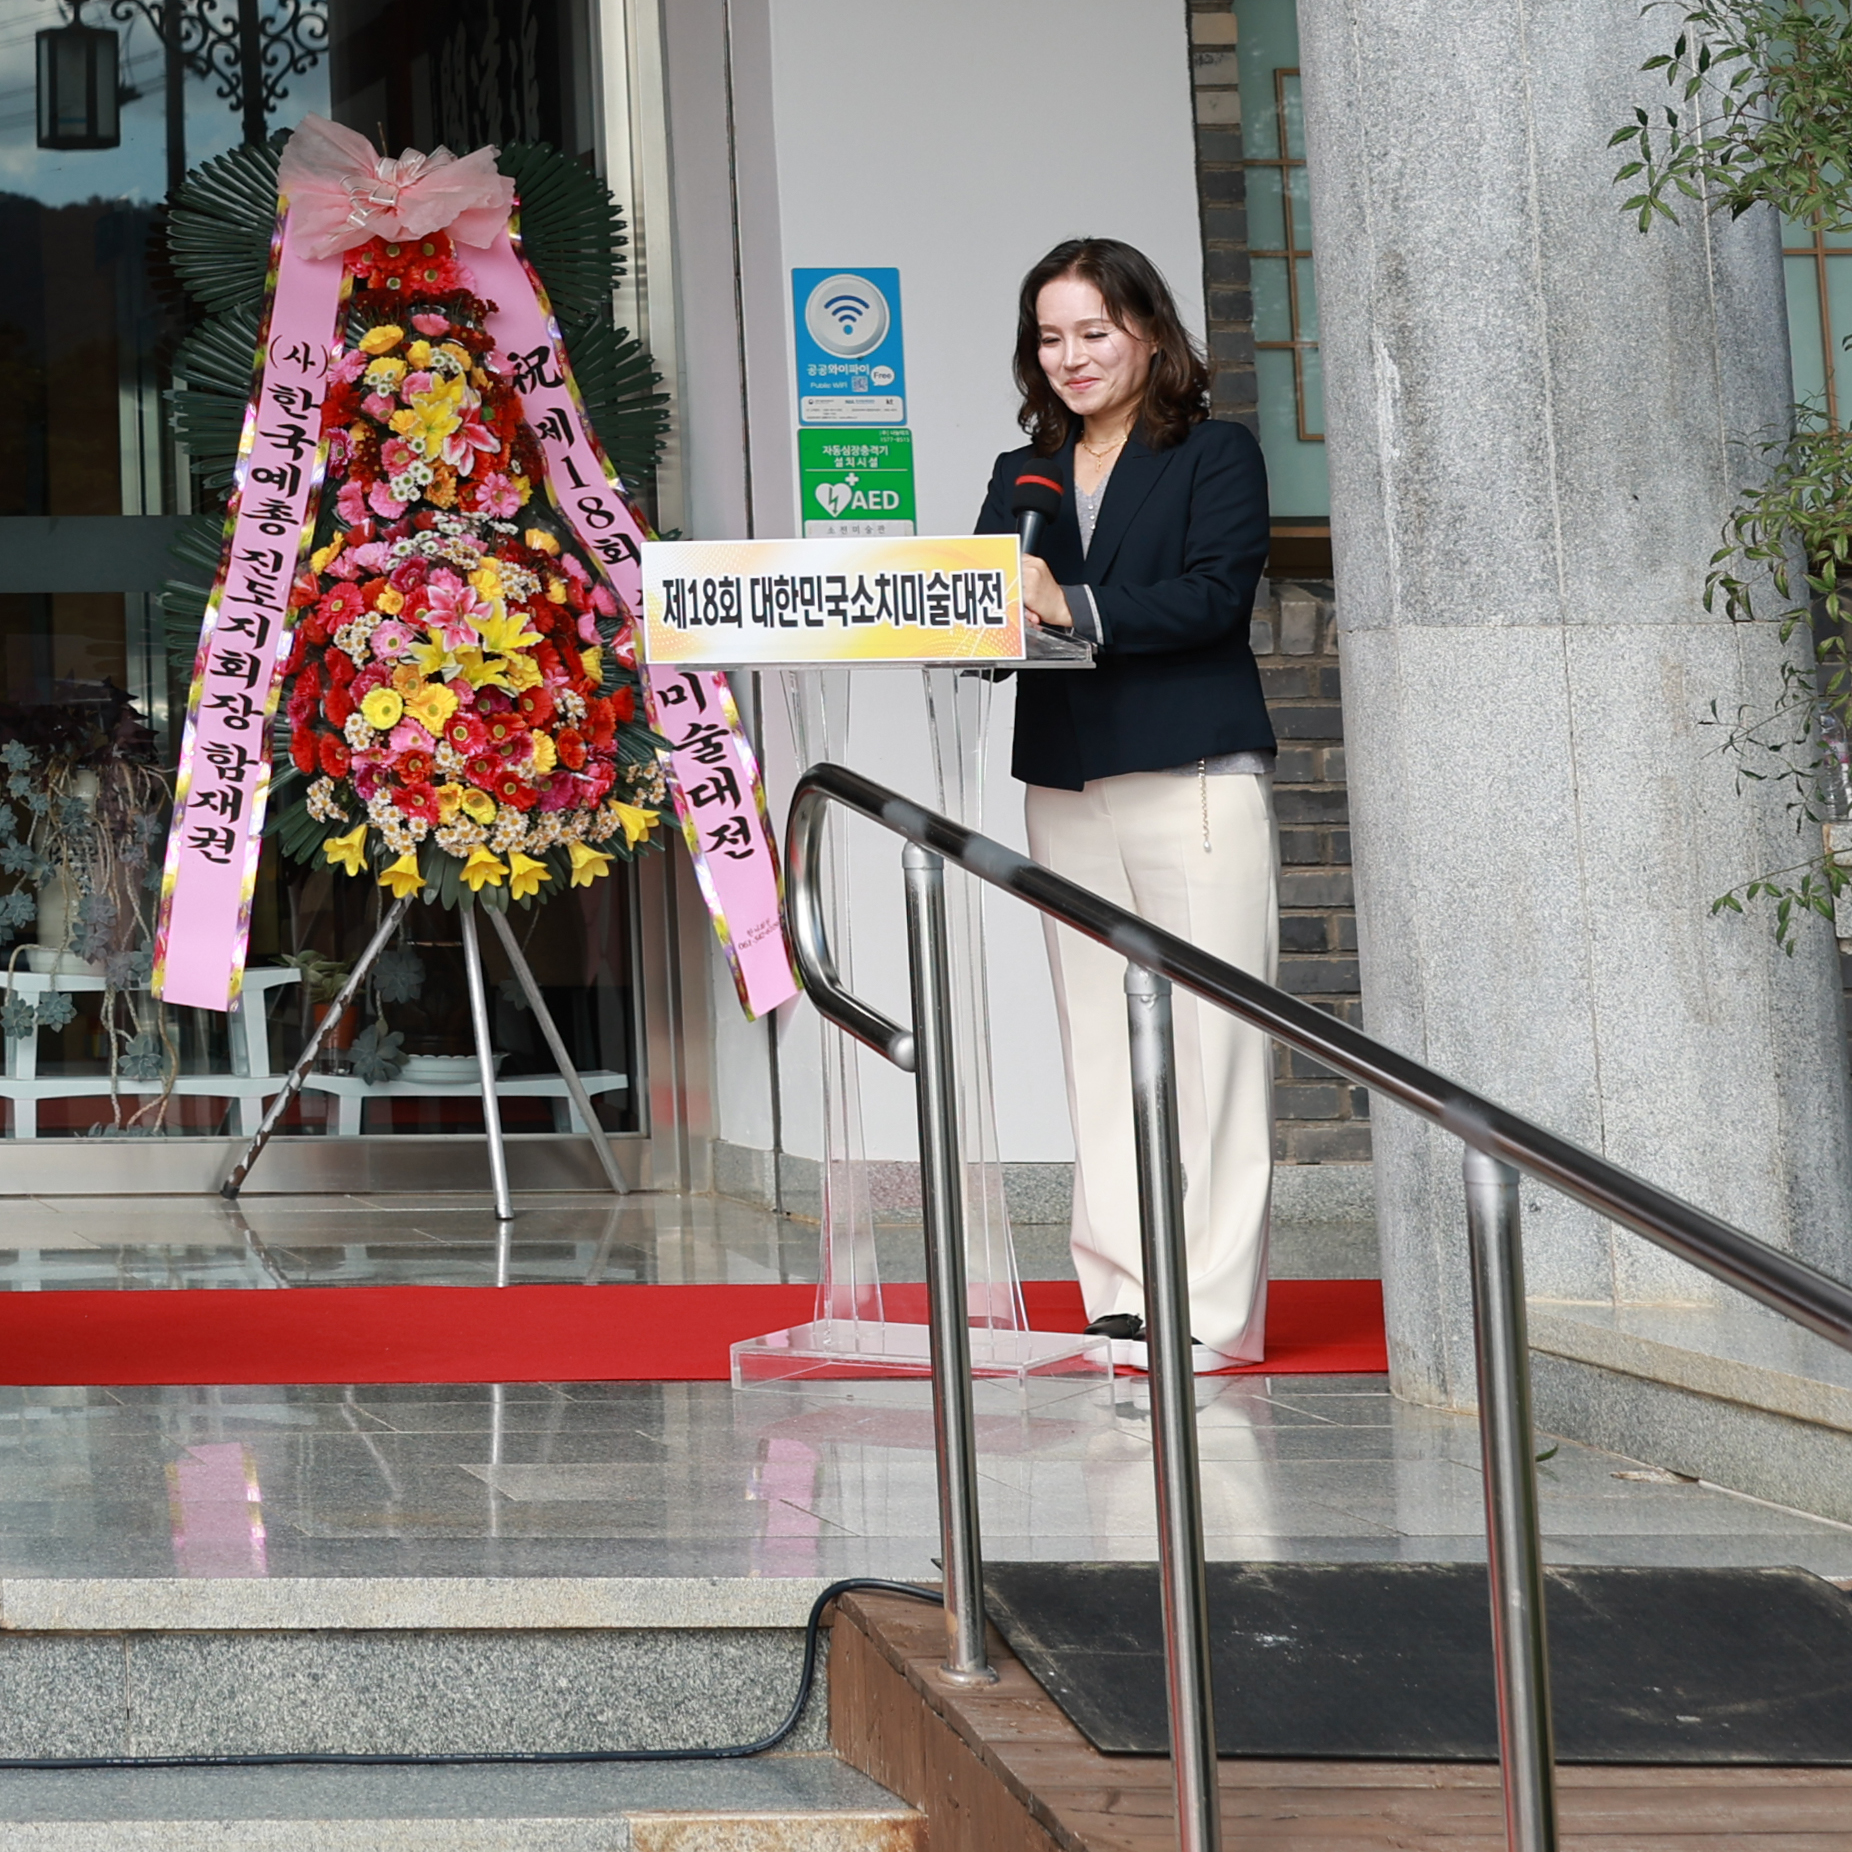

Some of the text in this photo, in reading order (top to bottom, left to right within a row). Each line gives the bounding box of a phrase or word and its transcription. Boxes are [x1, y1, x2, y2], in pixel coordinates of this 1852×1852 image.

[507, 345, 565, 395] 祝
[807, 363, 870, 376] 공공와이파이
[873, 371, 892, 380] Free
[810, 381, 831, 389] Public
[822, 444, 889, 456] 자동심장충격기
[834, 457, 879, 468] 설치시설
[851, 490, 900, 510] AED
[662, 571, 1004, 630] 제18회 대한민국소치미술대전
[202, 547, 286, 731] 진도지회장
[187, 739, 260, 865] 함재권
